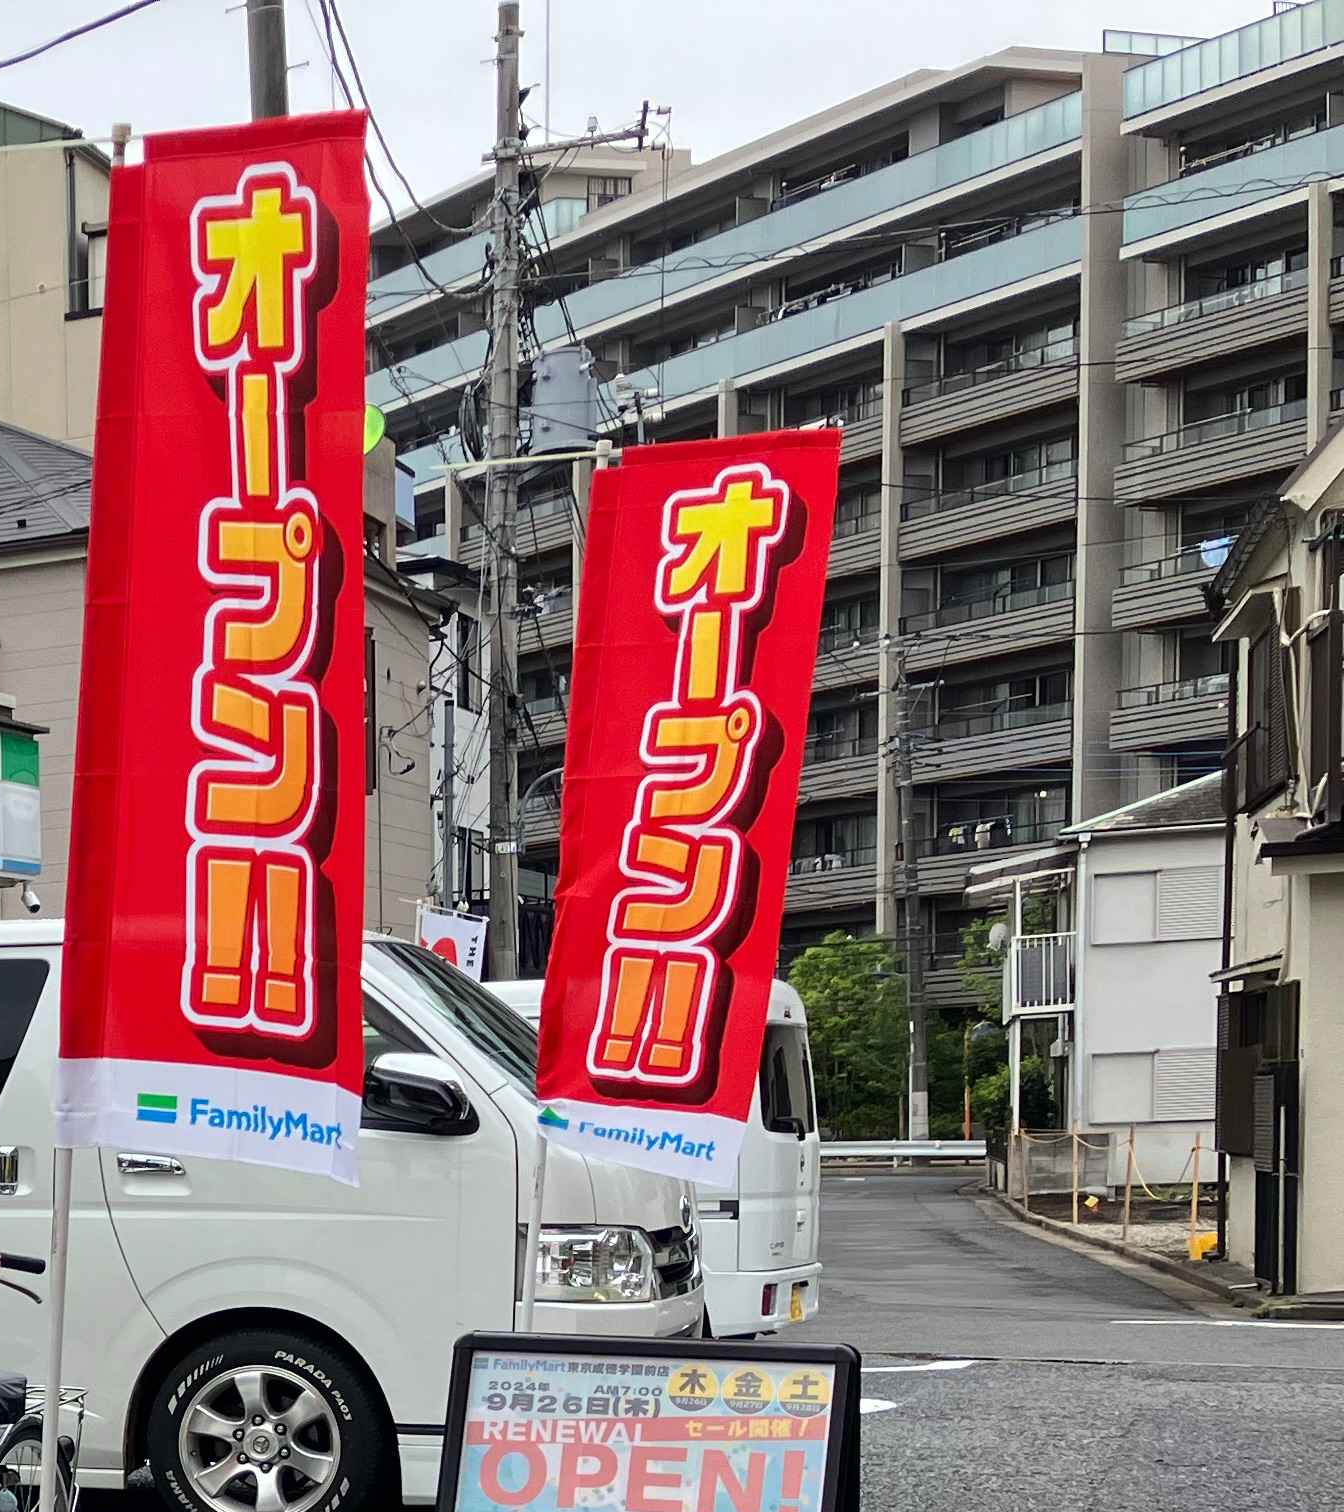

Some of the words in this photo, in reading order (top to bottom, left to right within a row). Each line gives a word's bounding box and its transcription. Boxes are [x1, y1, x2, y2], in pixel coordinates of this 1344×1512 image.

[182, 160, 323, 1037] オープン!!
[586, 462, 791, 1087] オープン!!
[274, 1349, 333, 1389] PARADA
[493, 1358, 567, 1374] FamilyMart
[567, 1361, 670, 1377] 東京成徳学園前店
[487, 1380, 551, 1393] 2024年
[592, 1384, 663, 1398] AM7:00
[678, 1368, 708, 1395] 木
[733, 1371, 763, 1399] 金
[790, 1374, 820, 1401] 土
[485, 1392, 662, 1419] 9月26日(木)
